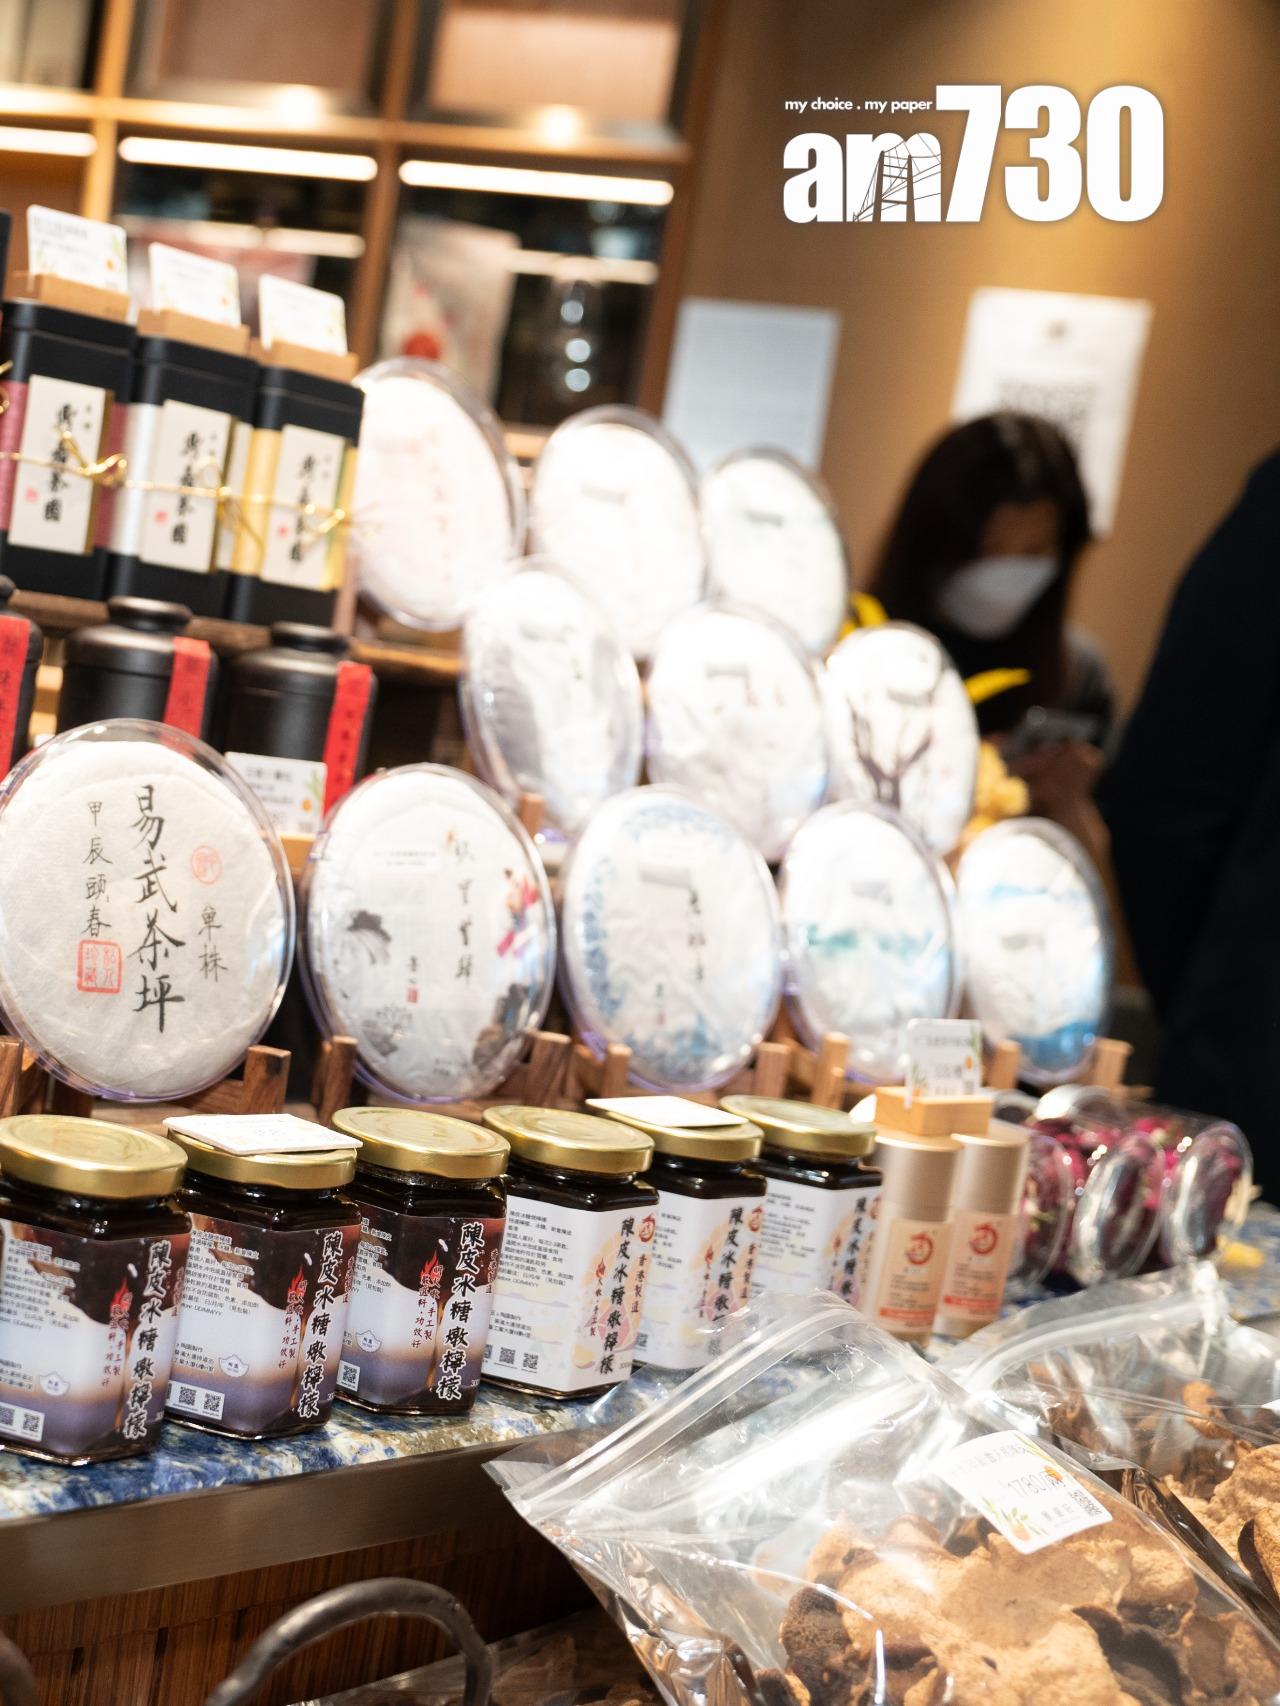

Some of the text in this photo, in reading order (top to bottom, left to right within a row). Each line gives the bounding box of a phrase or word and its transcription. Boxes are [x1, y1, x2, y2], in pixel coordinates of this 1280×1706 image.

[81, 800, 113, 937] 甲辰頭春
[127, 784, 187, 1033] 易武茶坪
